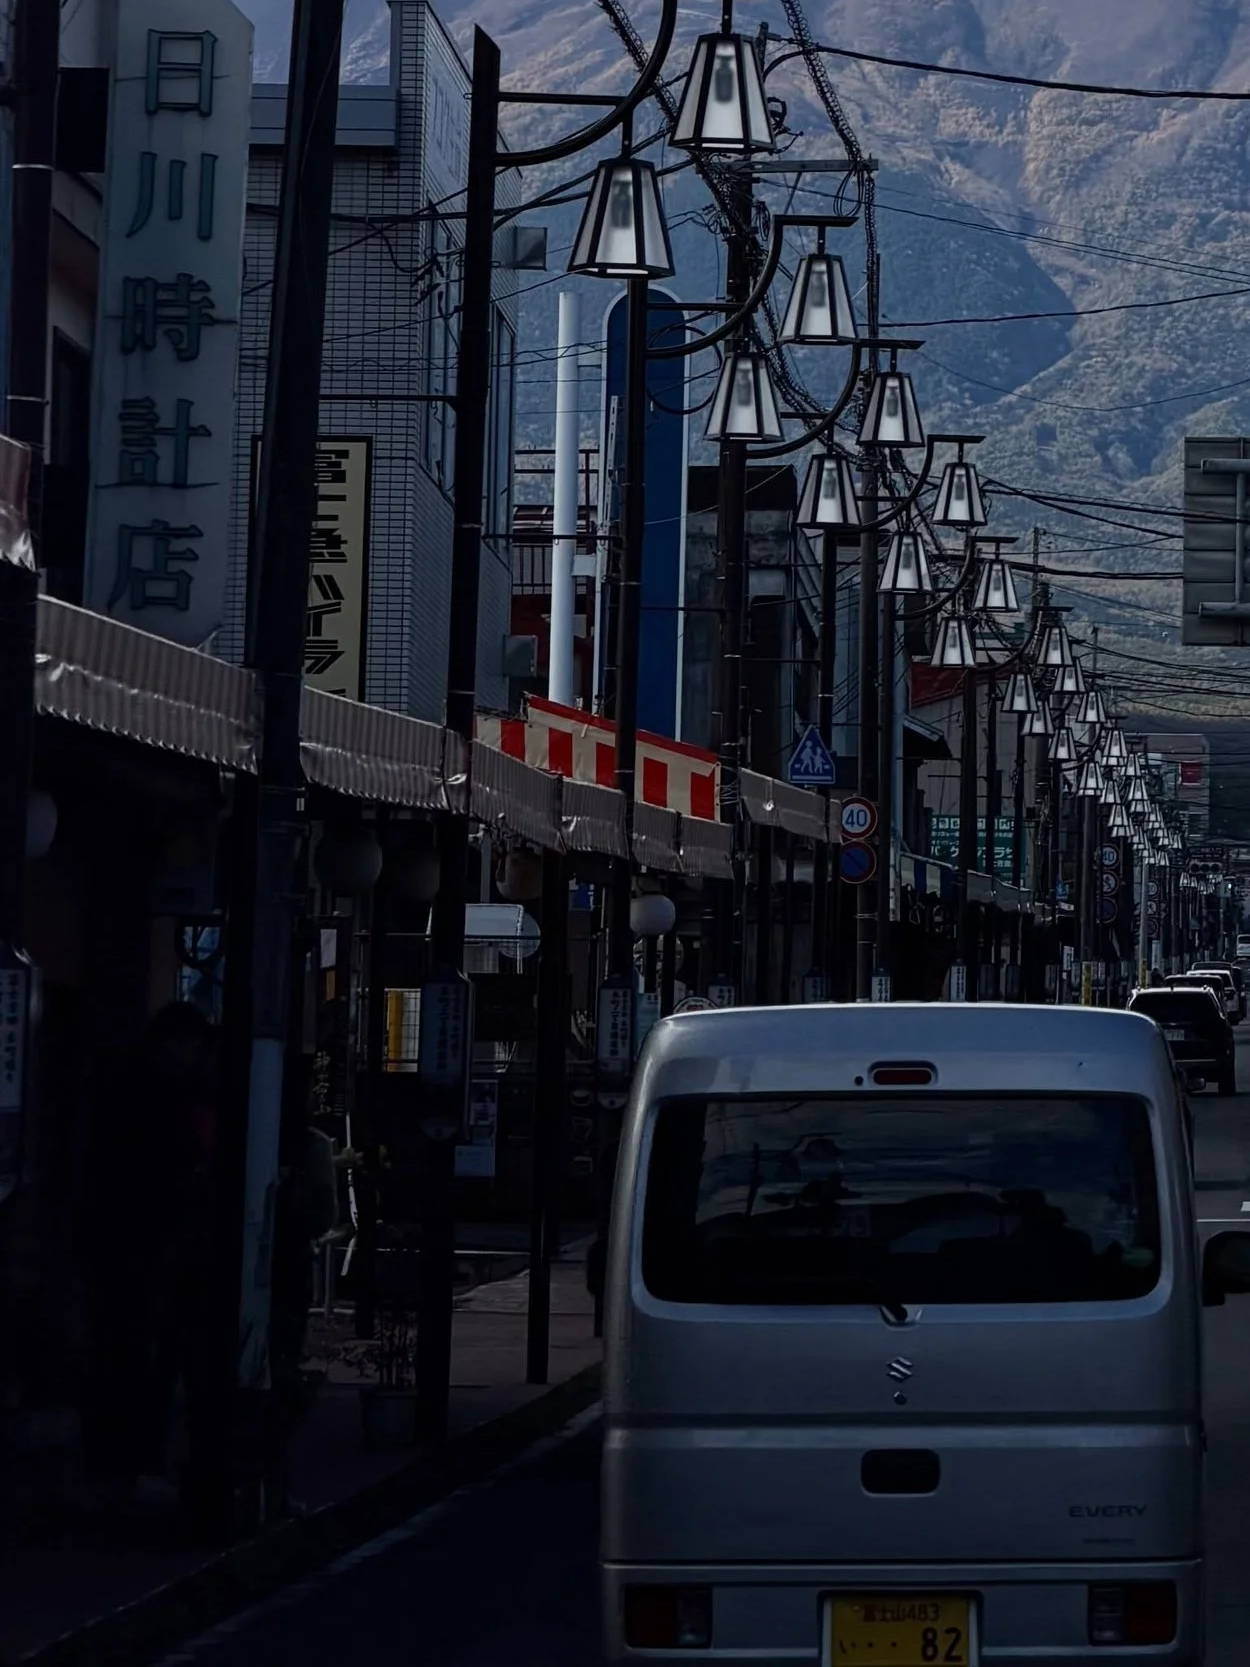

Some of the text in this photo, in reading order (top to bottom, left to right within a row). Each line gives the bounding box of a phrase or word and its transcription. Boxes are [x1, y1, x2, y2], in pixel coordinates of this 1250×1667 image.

[107, 27, 217, 613] 日川時計店
[845, 809, 868, 828] 40
[1068, 1504, 1148, 1519] EVERY
